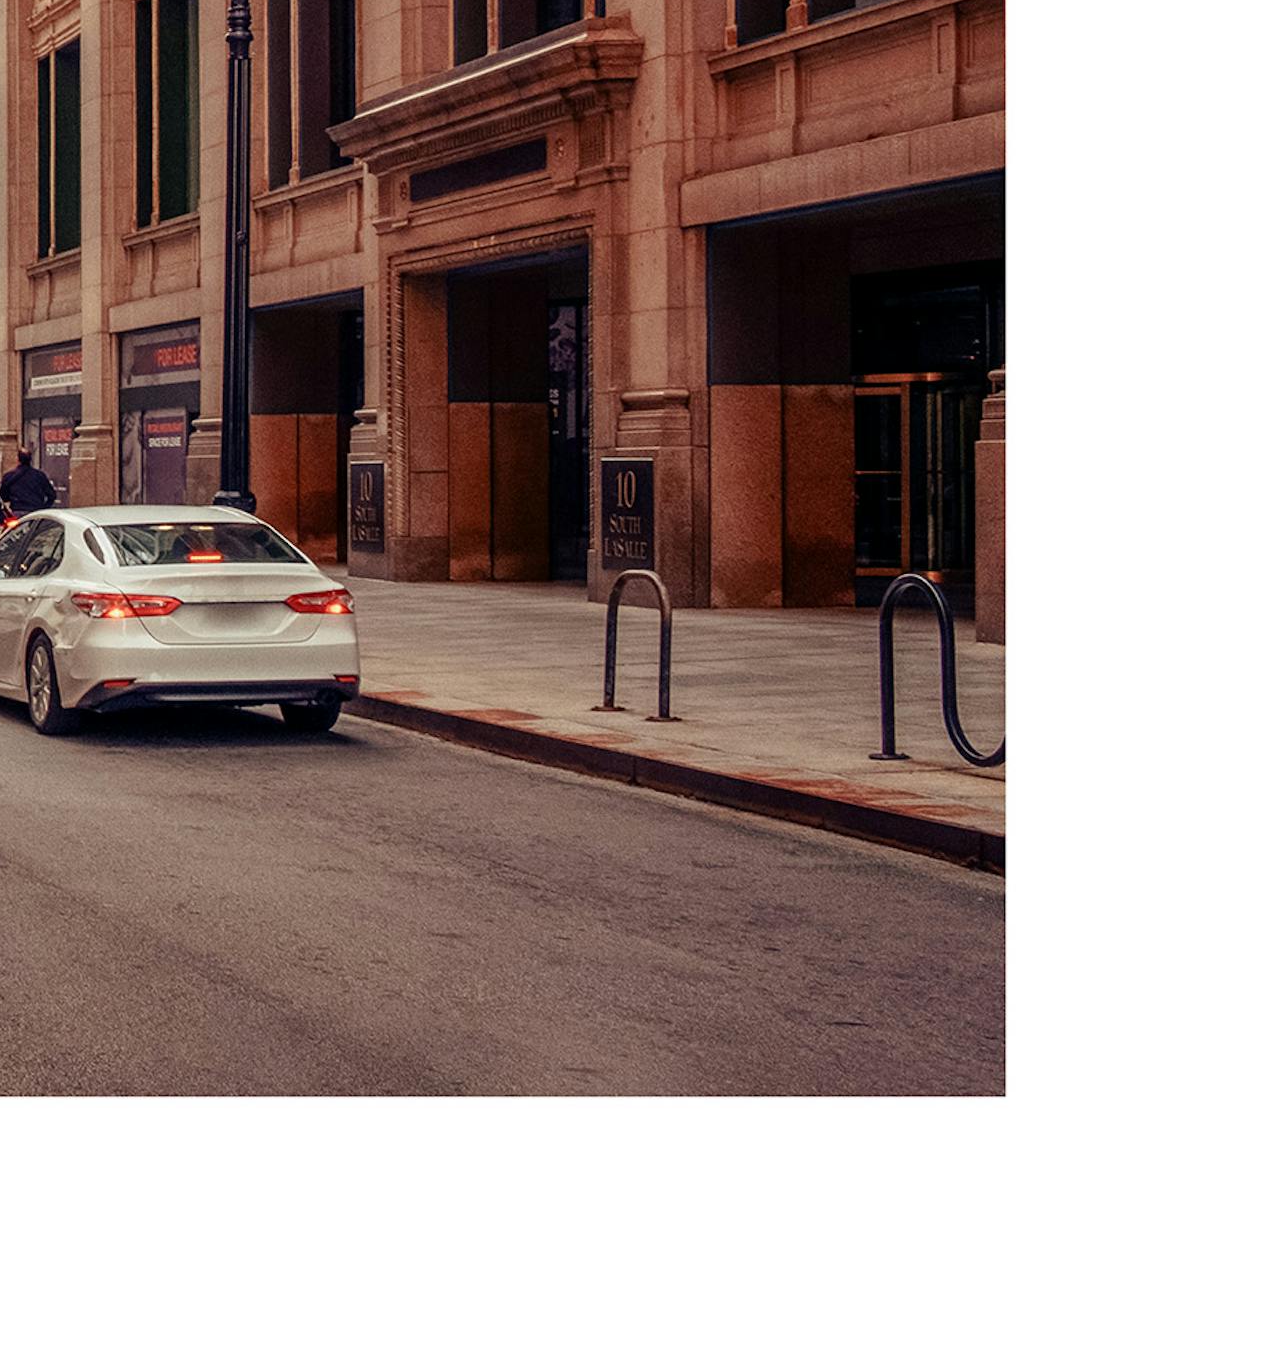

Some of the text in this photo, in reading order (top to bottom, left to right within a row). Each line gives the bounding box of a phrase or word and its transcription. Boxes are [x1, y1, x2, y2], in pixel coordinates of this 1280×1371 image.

[173, 343, 197, 364] LEASE
[360, 471, 373, 501] 10
[616, 471, 637, 508] 10
